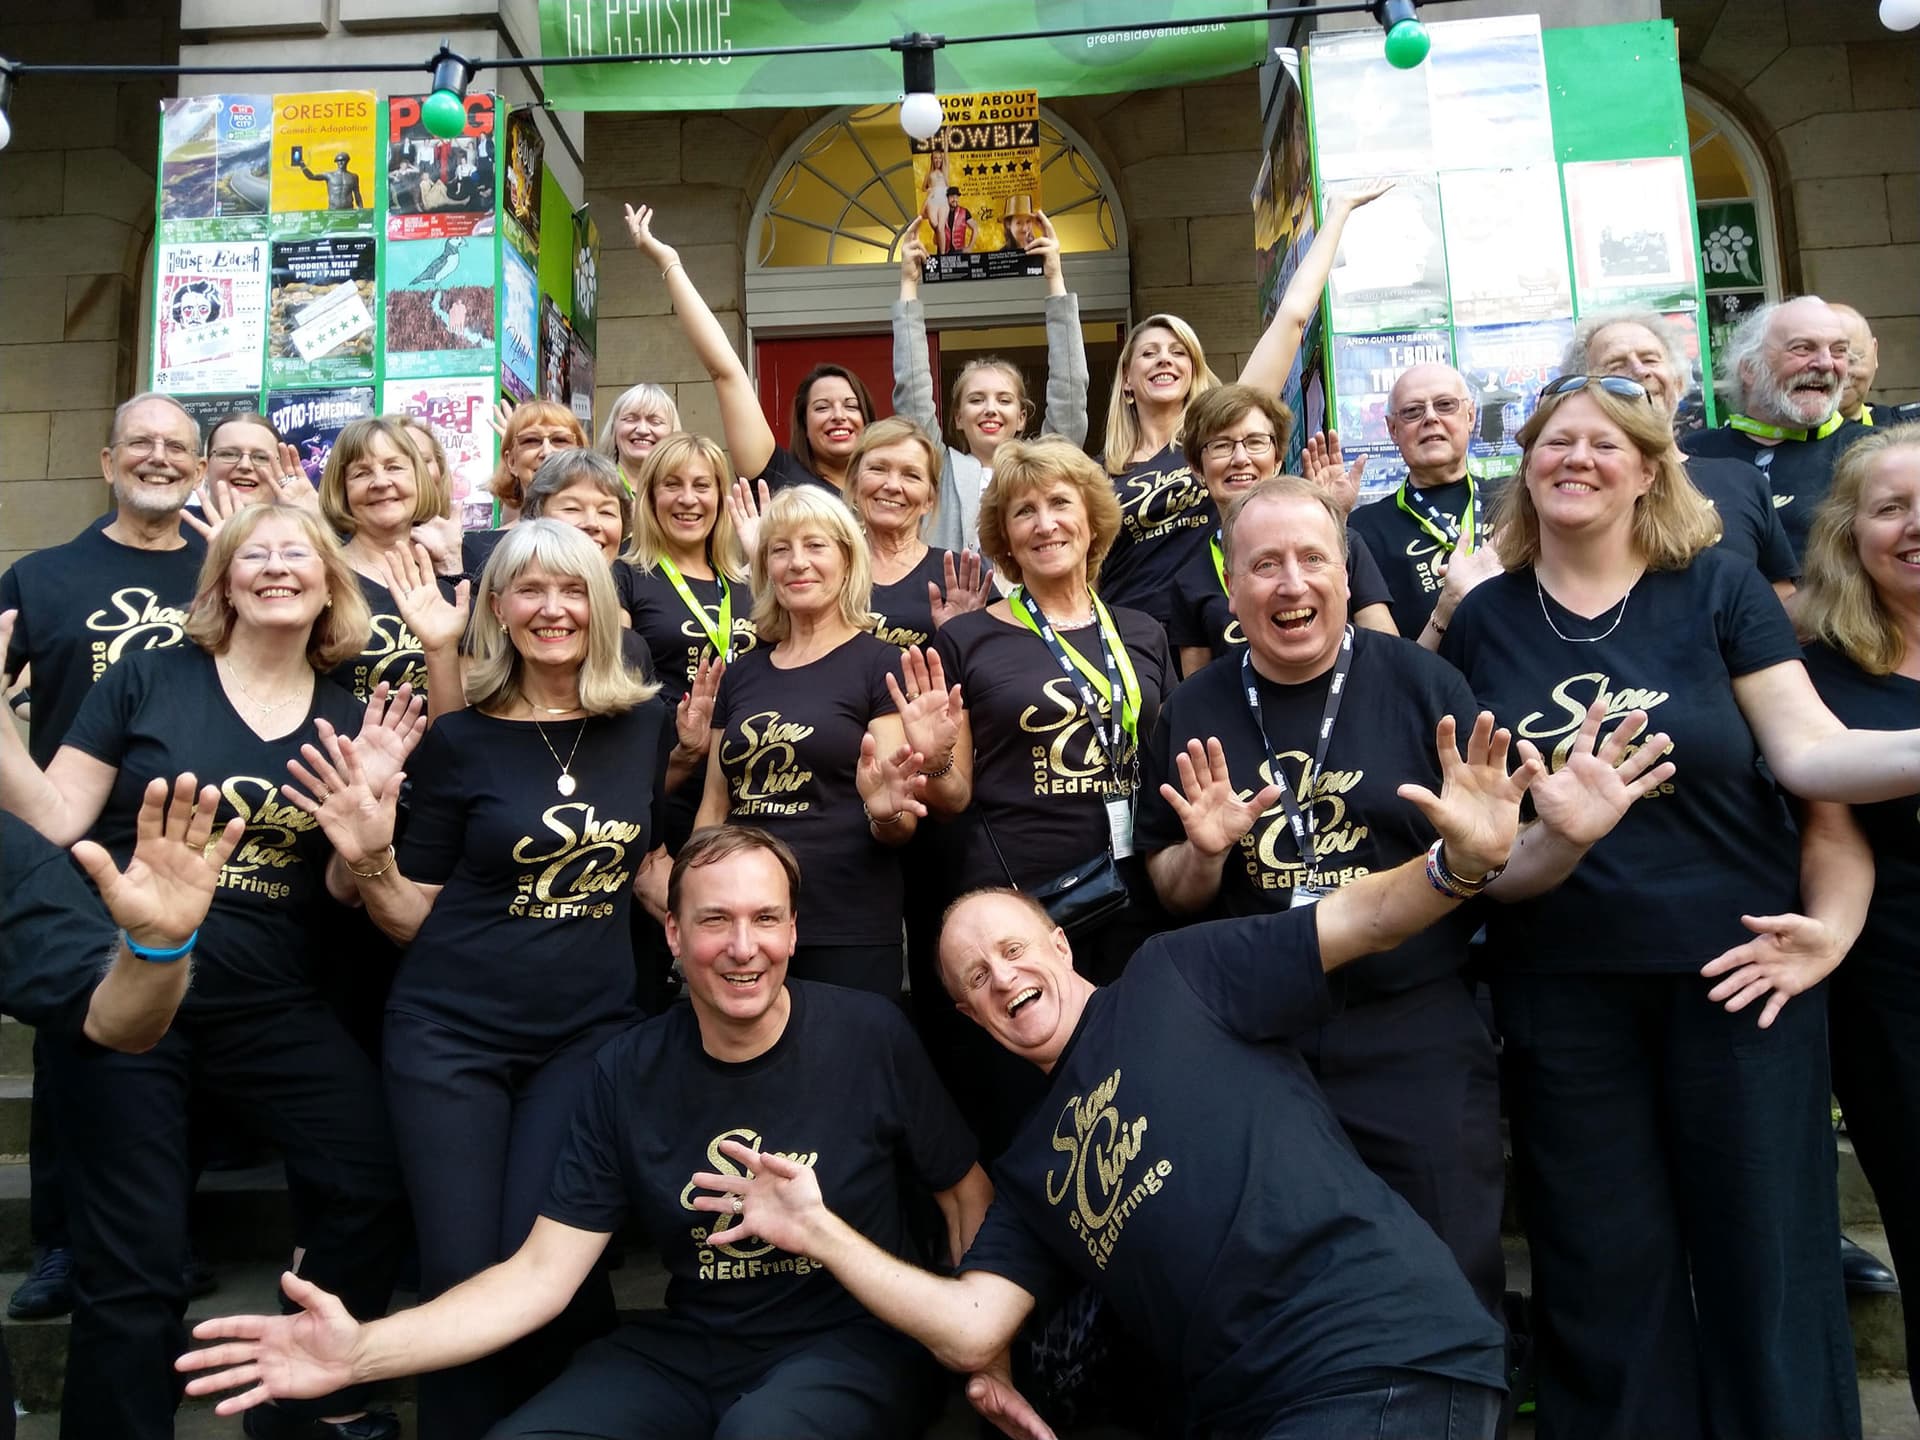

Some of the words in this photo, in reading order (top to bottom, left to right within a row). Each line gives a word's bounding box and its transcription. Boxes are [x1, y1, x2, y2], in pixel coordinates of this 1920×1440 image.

[282, 102, 367, 120] ORESTES
[939, 97, 974, 109] HOW
[981, 93, 1036, 106] ABOUT
[978, 107, 1036, 120] ABOUT
[280, 125, 317, 136] Comedic
[319, 123, 369, 134] Adaptation
[331, 260, 358, 269] WILLIE
[1345, 336, 1370, 346] ANDY
[1116, 467, 1193, 510] Show
[1138, 477, 1210, 528] Choir
[1517, 672, 1670, 738] Show
[721, 711, 815, 765] Show
[740, 741, 812, 800] Choir
[1032, 745, 1050, 796] 2018
[1237, 750, 1365, 818] Show
[191, 775, 321, 832] Show
[512, 802, 641, 865] Show
[535, 840, 630, 904] Choir
[1046, 1068, 1122, 1206] Show
[1076, 1105, 1149, 1230] Choir
